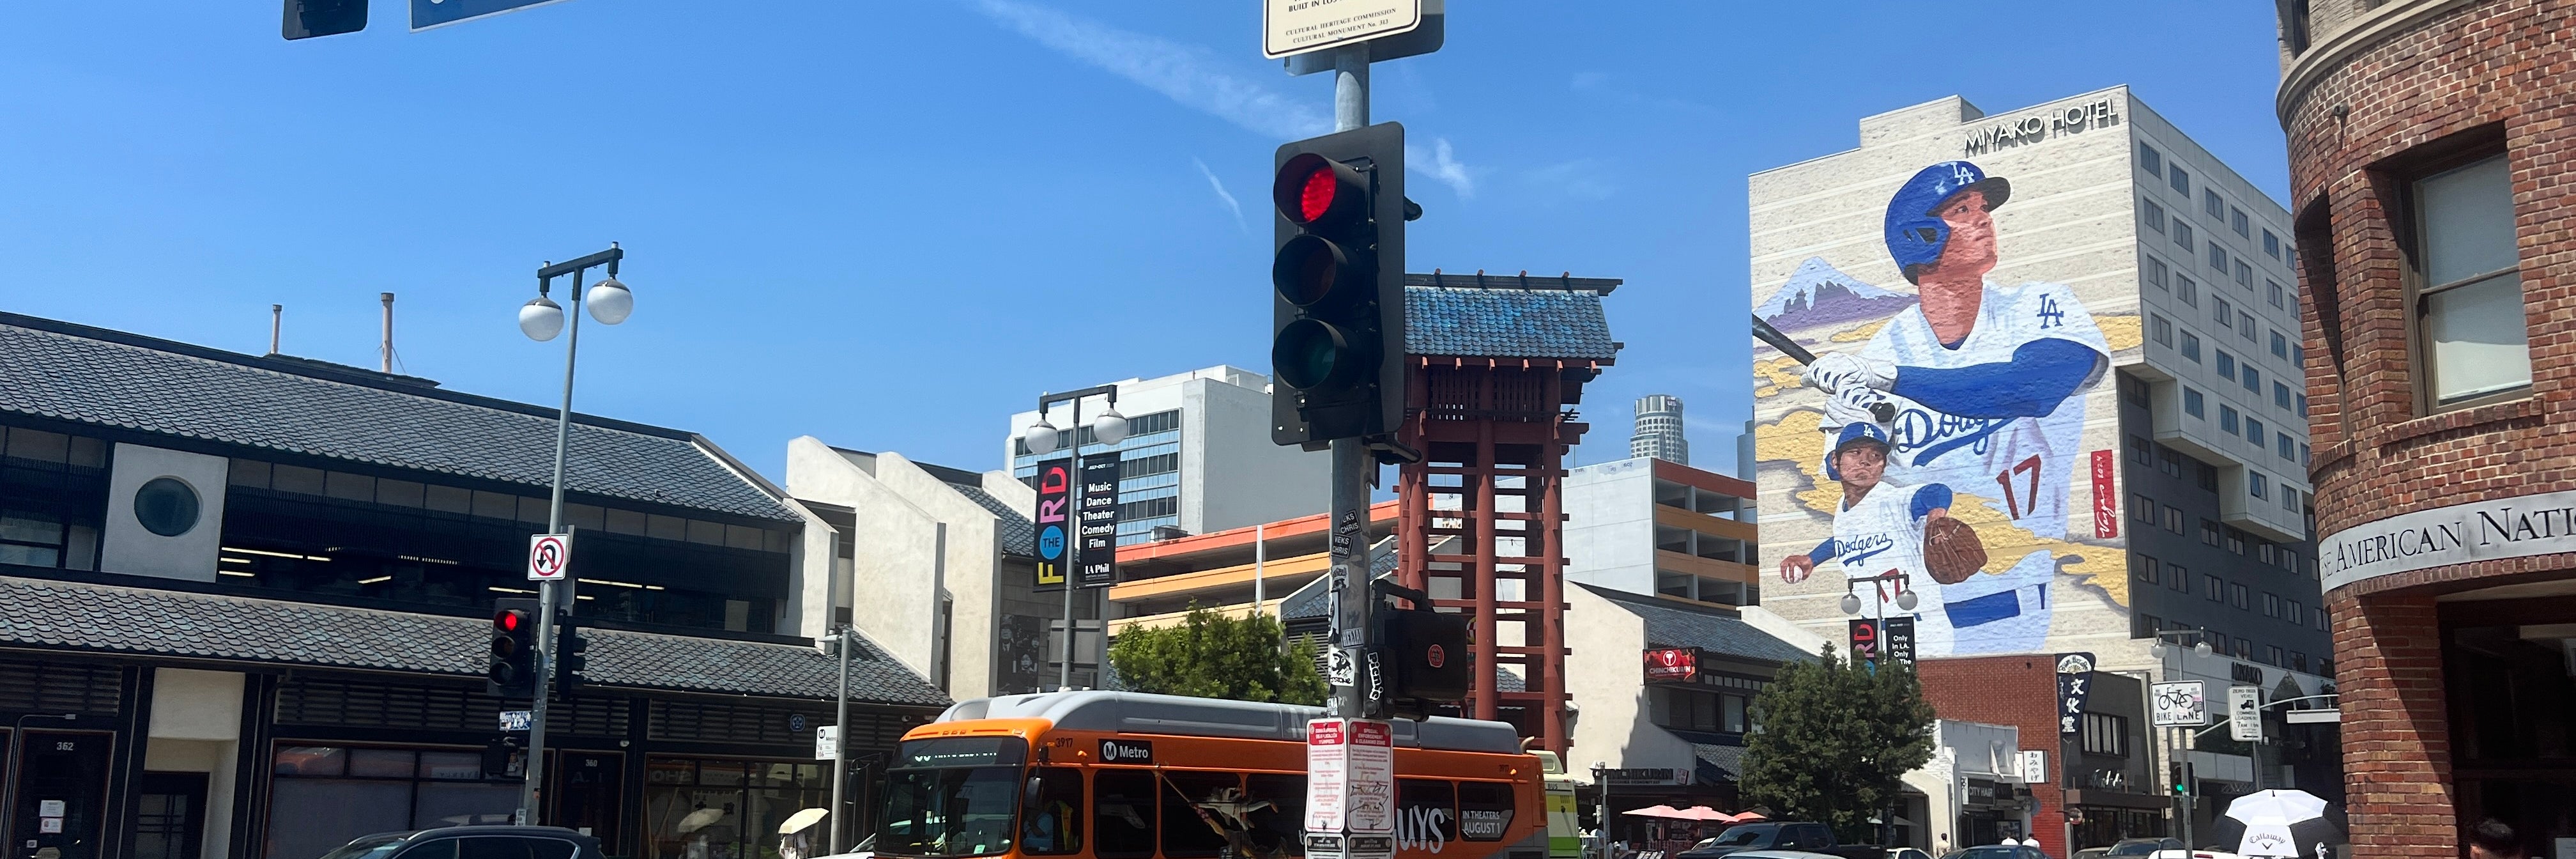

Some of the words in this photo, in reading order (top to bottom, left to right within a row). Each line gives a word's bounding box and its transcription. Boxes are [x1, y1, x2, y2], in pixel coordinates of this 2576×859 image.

[1289, 2, 1308, 12] BUILT
[1286, 26, 1318, 36] CULTURAL
[1320, 18, 1351, 29] HERITAGE
[1353, 8, 1397, 22] COMMISSION
[1293, 33, 1325, 43] CULTURAL
[1328, 24, 1365, 36] MONUMENT
[1964, 116, 2044, 151] MIYAKO
[2051, 98, 2117, 130] HOTEL
[1950, 161, 1975, 186] LA
[2036, 293, 2064, 329] LA
[1863, 424, 1874, 438] LA
[1894, 408, 1989, 455] Dodg
[1088, 481, 1112, 493] Music
[1996, 453, 2042, 520] 17
[1087, 497, 1112, 507] Dance
[1083, 511, 1115, 521] Theater
[1082, 523, 1115, 535] Comedy
[1340, 522, 1359, 534] CHRIS
[1043, 537, 1061, 548] THE
[1089, 539, 1106, 548] Film
[2336, 521, 2462, 573] AMERICAN
[1332, 545, 1349, 555] CHRIS
[1834, 532, 1892, 567] Dodgers
[1085, 565, 1094, 575] LA
[1095, 563, 1110, 574] Phil
[1649, 665, 1691, 674] CHINCHIKURIN
[2062, 678, 2085, 732] 文化堂
[2156, 711, 2172, 722] BIKE
[2177, 711, 2200, 720] LANE
[56, 741, 74, 751] 362
[1056, 738, 1073, 748] 3917
[1119, 745, 1149, 759] Metro
[585, 759, 598, 767] 360
[2029, 752, 2039, 782] おみやげ
[1968, 786, 1981, 796] CITY
[1981, 787, 1993, 797] HAIR
[1462, 810, 1469, 819] IN
[1471, 810, 1500, 819] THEATERS
[1393, 805, 1445, 855] UYS
[1464, 822, 1496, 834] AUGUST
[1497, 822, 1500, 834] 1
[2249, 832, 2286, 844] Callaway
